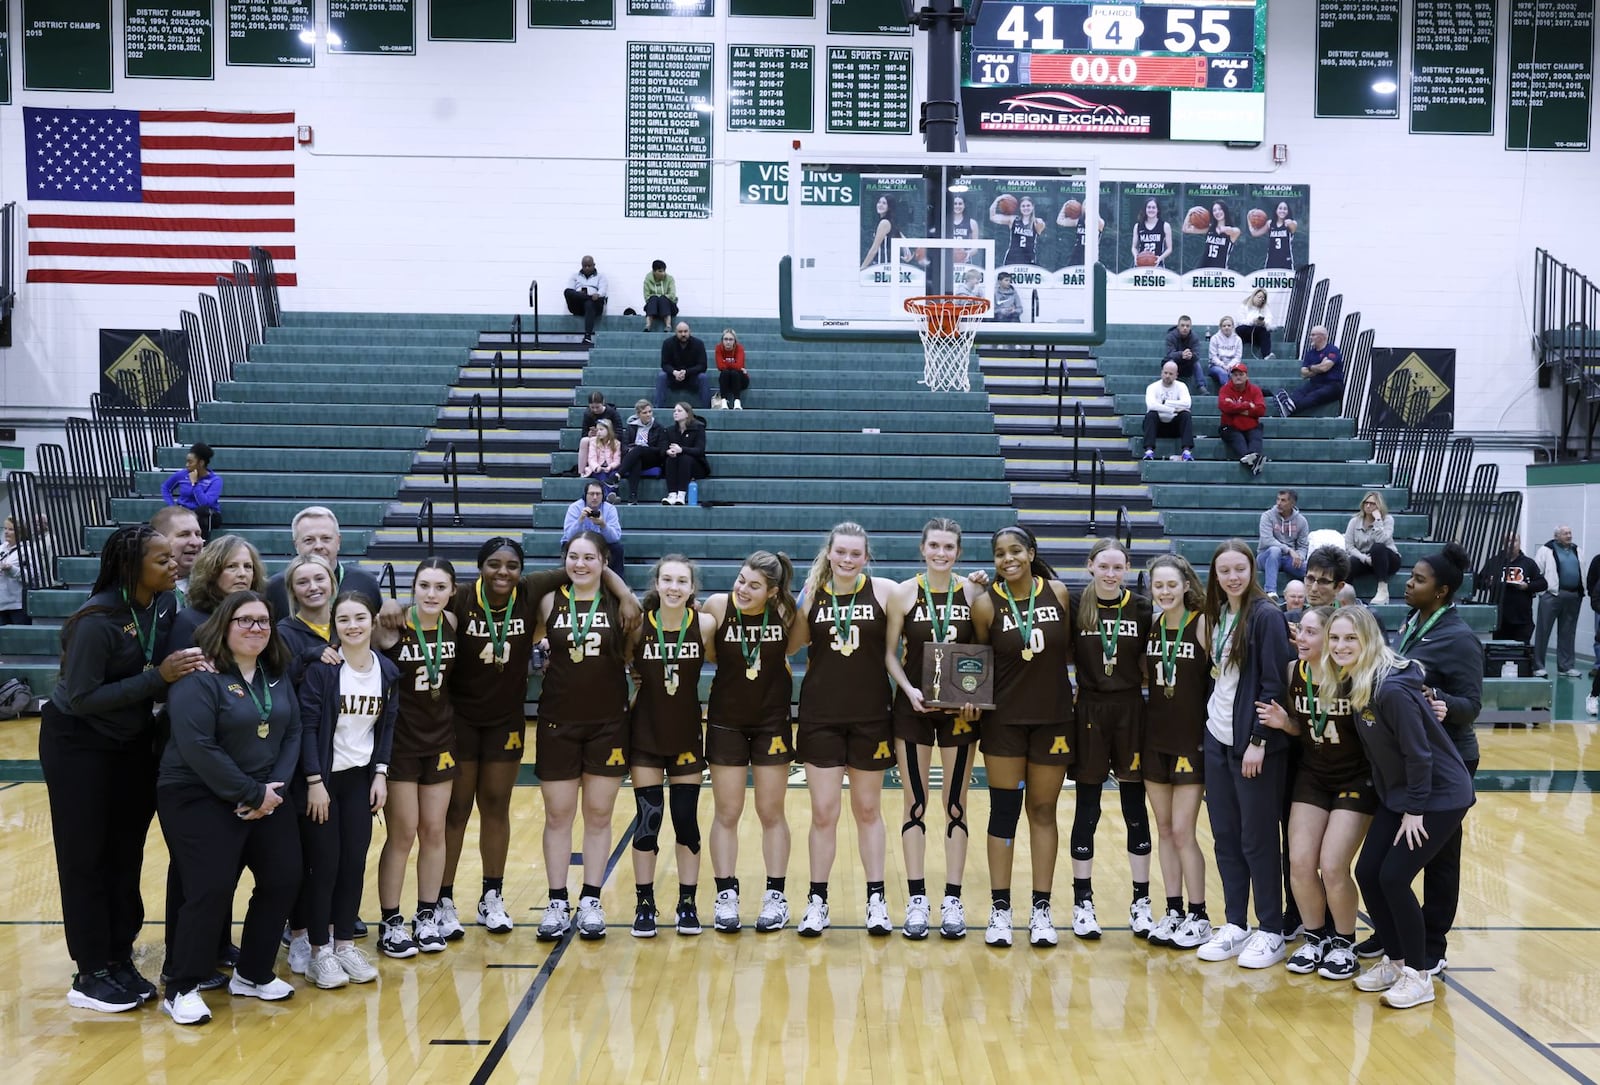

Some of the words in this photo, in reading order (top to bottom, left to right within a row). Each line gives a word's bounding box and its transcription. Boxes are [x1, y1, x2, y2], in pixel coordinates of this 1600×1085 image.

[997, 6, 1064, 49] 41
[1105, 20, 1122, 45] 4
[1164, 9, 1230, 53] 55
[734, 48, 750, 57] ALL
[754, 49, 784, 57] SPORTS
[791, 49, 808, 58] GMC
[831, 50, 847, 59] ALL
[851, 51, 881, 60] SPORTS
[889, 51, 909, 60] FAVC
[978, 54, 1014, 63] FOULS
[981, 64, 1009, 82] 10
[1070, 57, 1137, 83] 00.0
[1212, 59, 1248, 68] FOULS
[1223, 69, 1237, 88] 6
[981, 113, 1053, 124] FOREIGN
[1058, 114, 1150, 125] EXCHANGE
[759, 165, 843, 183] VISING
[748, 185, 852, 203] STUENTS
[1140, 234, 1161, 242] MASON
[1275, 238, 1281, 249] 3
[1207, 245, 1220, 258] 15
[1010, 274, 1041, 284] ROWS
[1134, 276, 1165, 286] RESIG
[1192, 276, 1235, 288] EHLERS
[1252, 278, 1295, 288] JOHNSO
[553, 612, 610, 629] ALTE
[814, 604, 874, 623] ALTER
[913, 604, 971, 622] ALTER
[1002, 606, 1060, 632] ALTER
[466, 618, 526, 637] ALTER
[724, 624, 784, 643] ALTER
[830, 624, 860, 651] 30
[398, 641, 456, 662] ALTER
[643, 641, 700, 660] ALTER
[1295, 695, 1353, 716] ALTER
[504, 731, 522, 750] A
[767, 735, 788, 756] A
[873, 740, 891, 759] A
[1049, 735, 1070, 754] A
[437, 751, 456, 771] A
[605, 747, 626, 766] A
[1175, 755, 1193, 773] A
